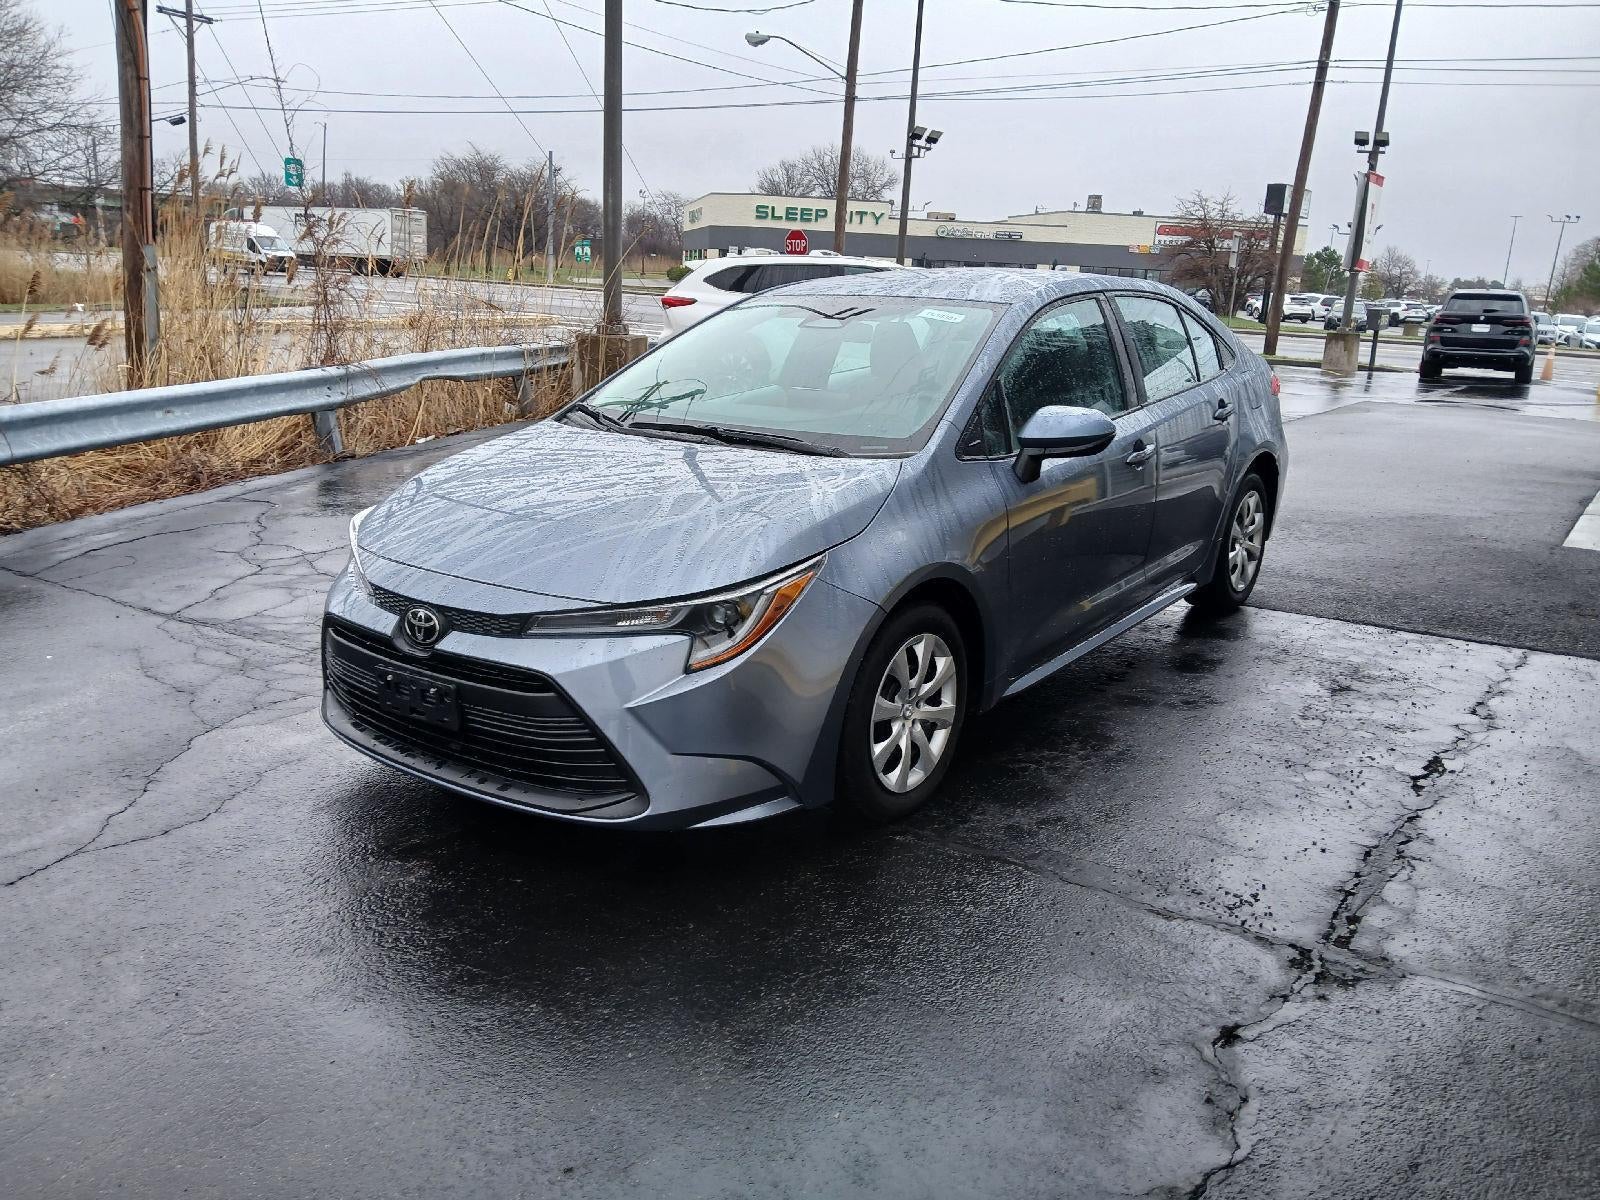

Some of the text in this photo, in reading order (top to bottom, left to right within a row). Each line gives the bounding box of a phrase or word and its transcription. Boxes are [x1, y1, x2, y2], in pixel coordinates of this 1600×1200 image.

[755, 203, 886, 226] SLEEP ITY
[786, 239, 807, 252] STOP
